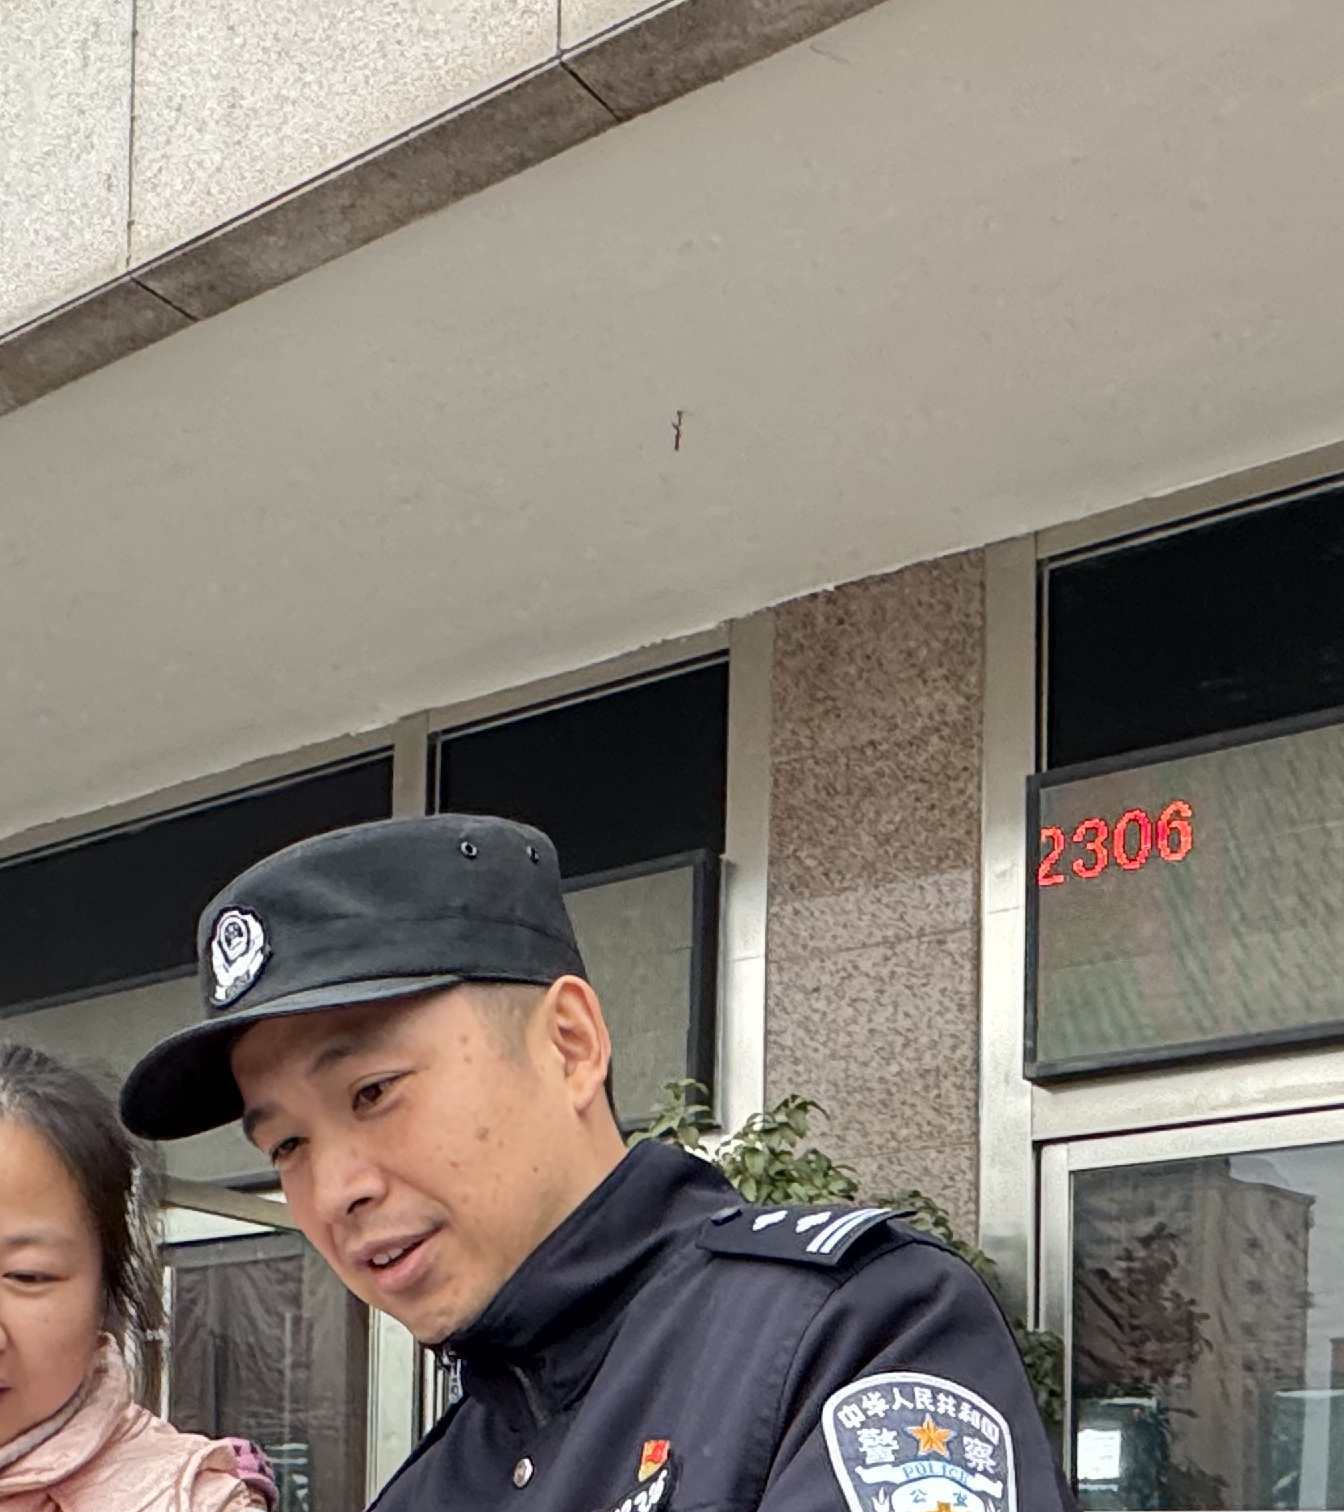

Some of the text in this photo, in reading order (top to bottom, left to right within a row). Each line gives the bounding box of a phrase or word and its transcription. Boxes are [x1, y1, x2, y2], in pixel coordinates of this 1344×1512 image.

[1038, 800, 1192, 886] 2306
[837, 1386, 1000, 1445] 中华人民共和国
[902, 1463, 969, 1485] POLICE
